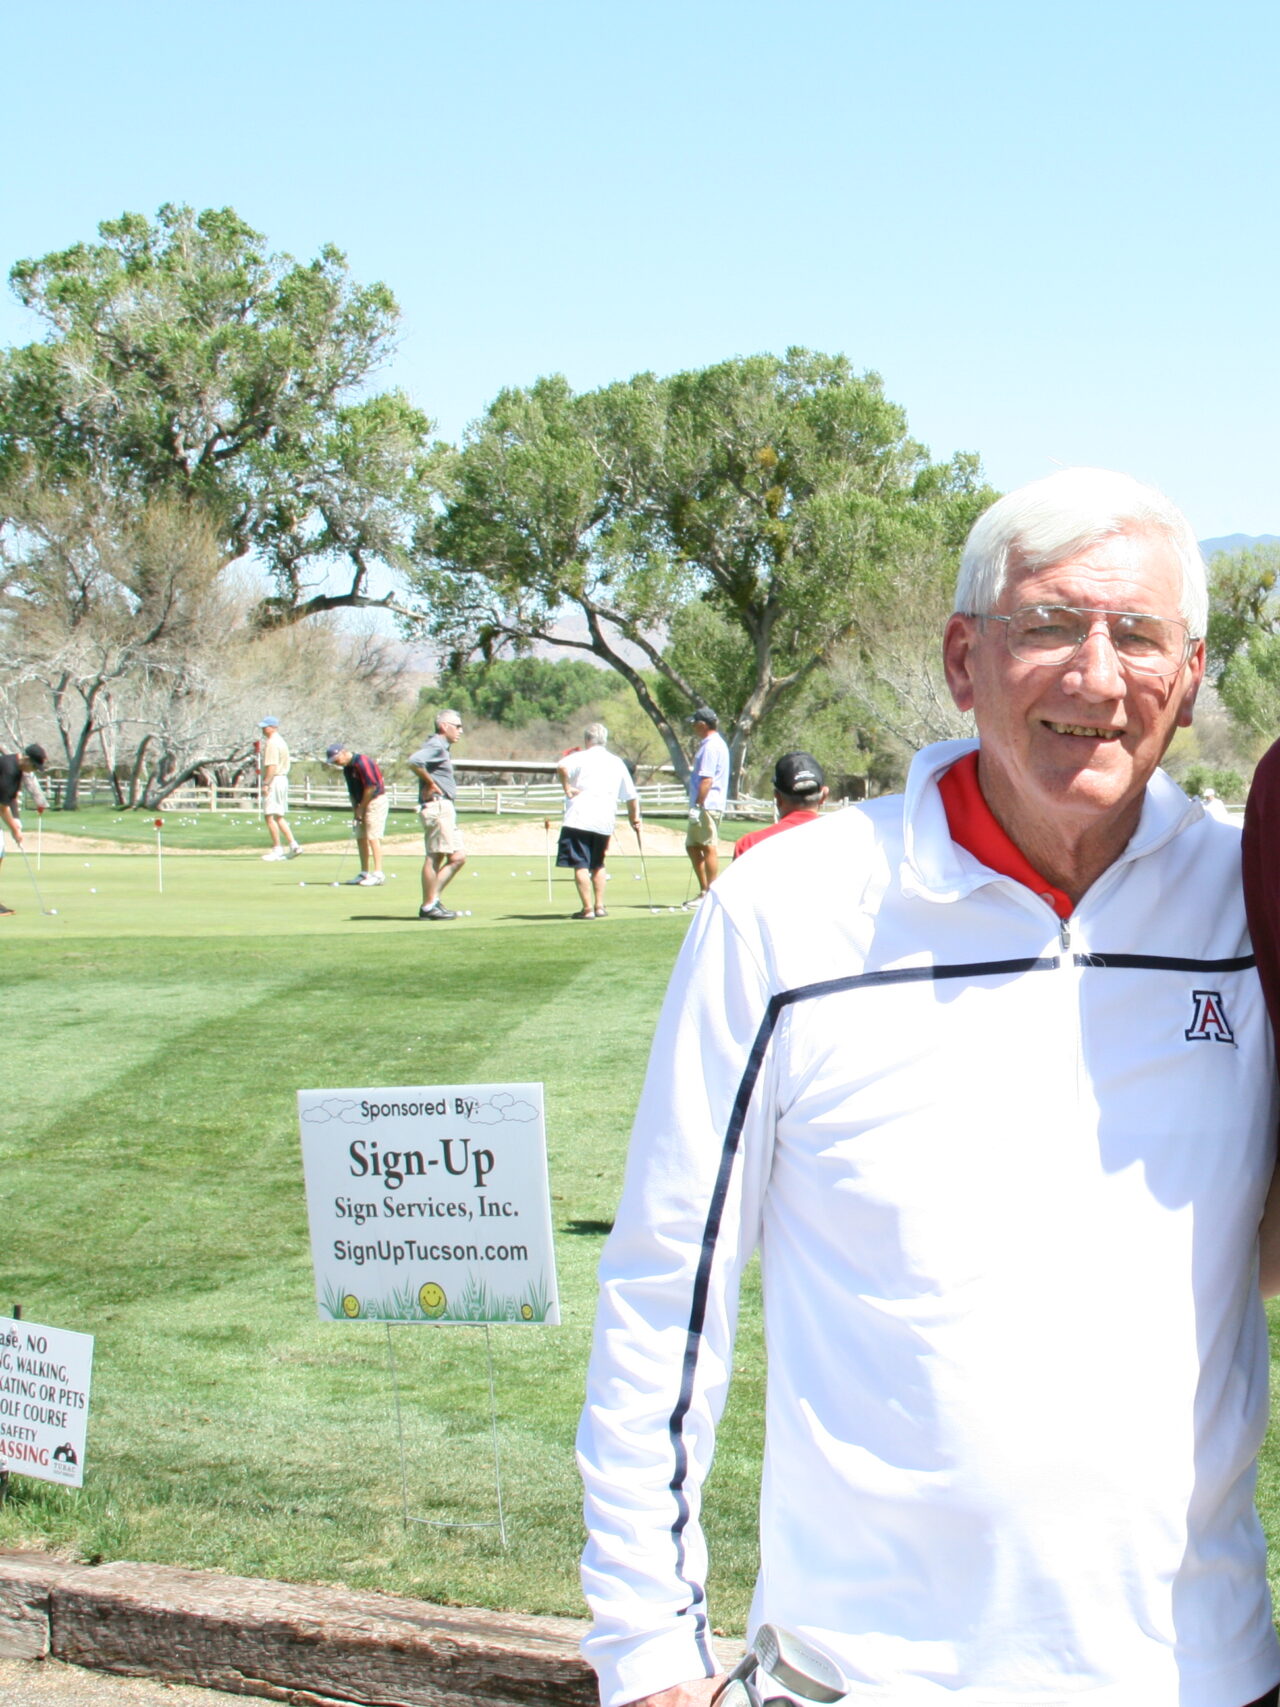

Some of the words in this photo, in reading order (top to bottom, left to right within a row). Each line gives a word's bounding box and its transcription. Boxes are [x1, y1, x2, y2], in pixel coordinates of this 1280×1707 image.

[1185, 990, 1235, 1044] A
[360, 1099, 447, 1120] Sponsored
[455, 1097, 479, 1118] By:
[349, 1138, 495, 1190] Sign-Up
[334, 1196, 378, 1225] Sign
[383, 1196, 474, 1222] Services,
[478, 1195, 519, 1218] Inc.
[334, 1240, 528, 1265] SignUpTucson.com
[27, 1334, 48, 1354] NO
[17, 1355, 69, 1386] WALKING,
[39, 1384, 56, 1403] OR
[59, 1389, 85, 1409] PETS
[0, 1398, 21, 1418] OLF
[23, 1403, 68, 1429] COURSE
[0, 1422, 38, 1443] SAFETY
[0, 1439, 49, 1466] ASSING
